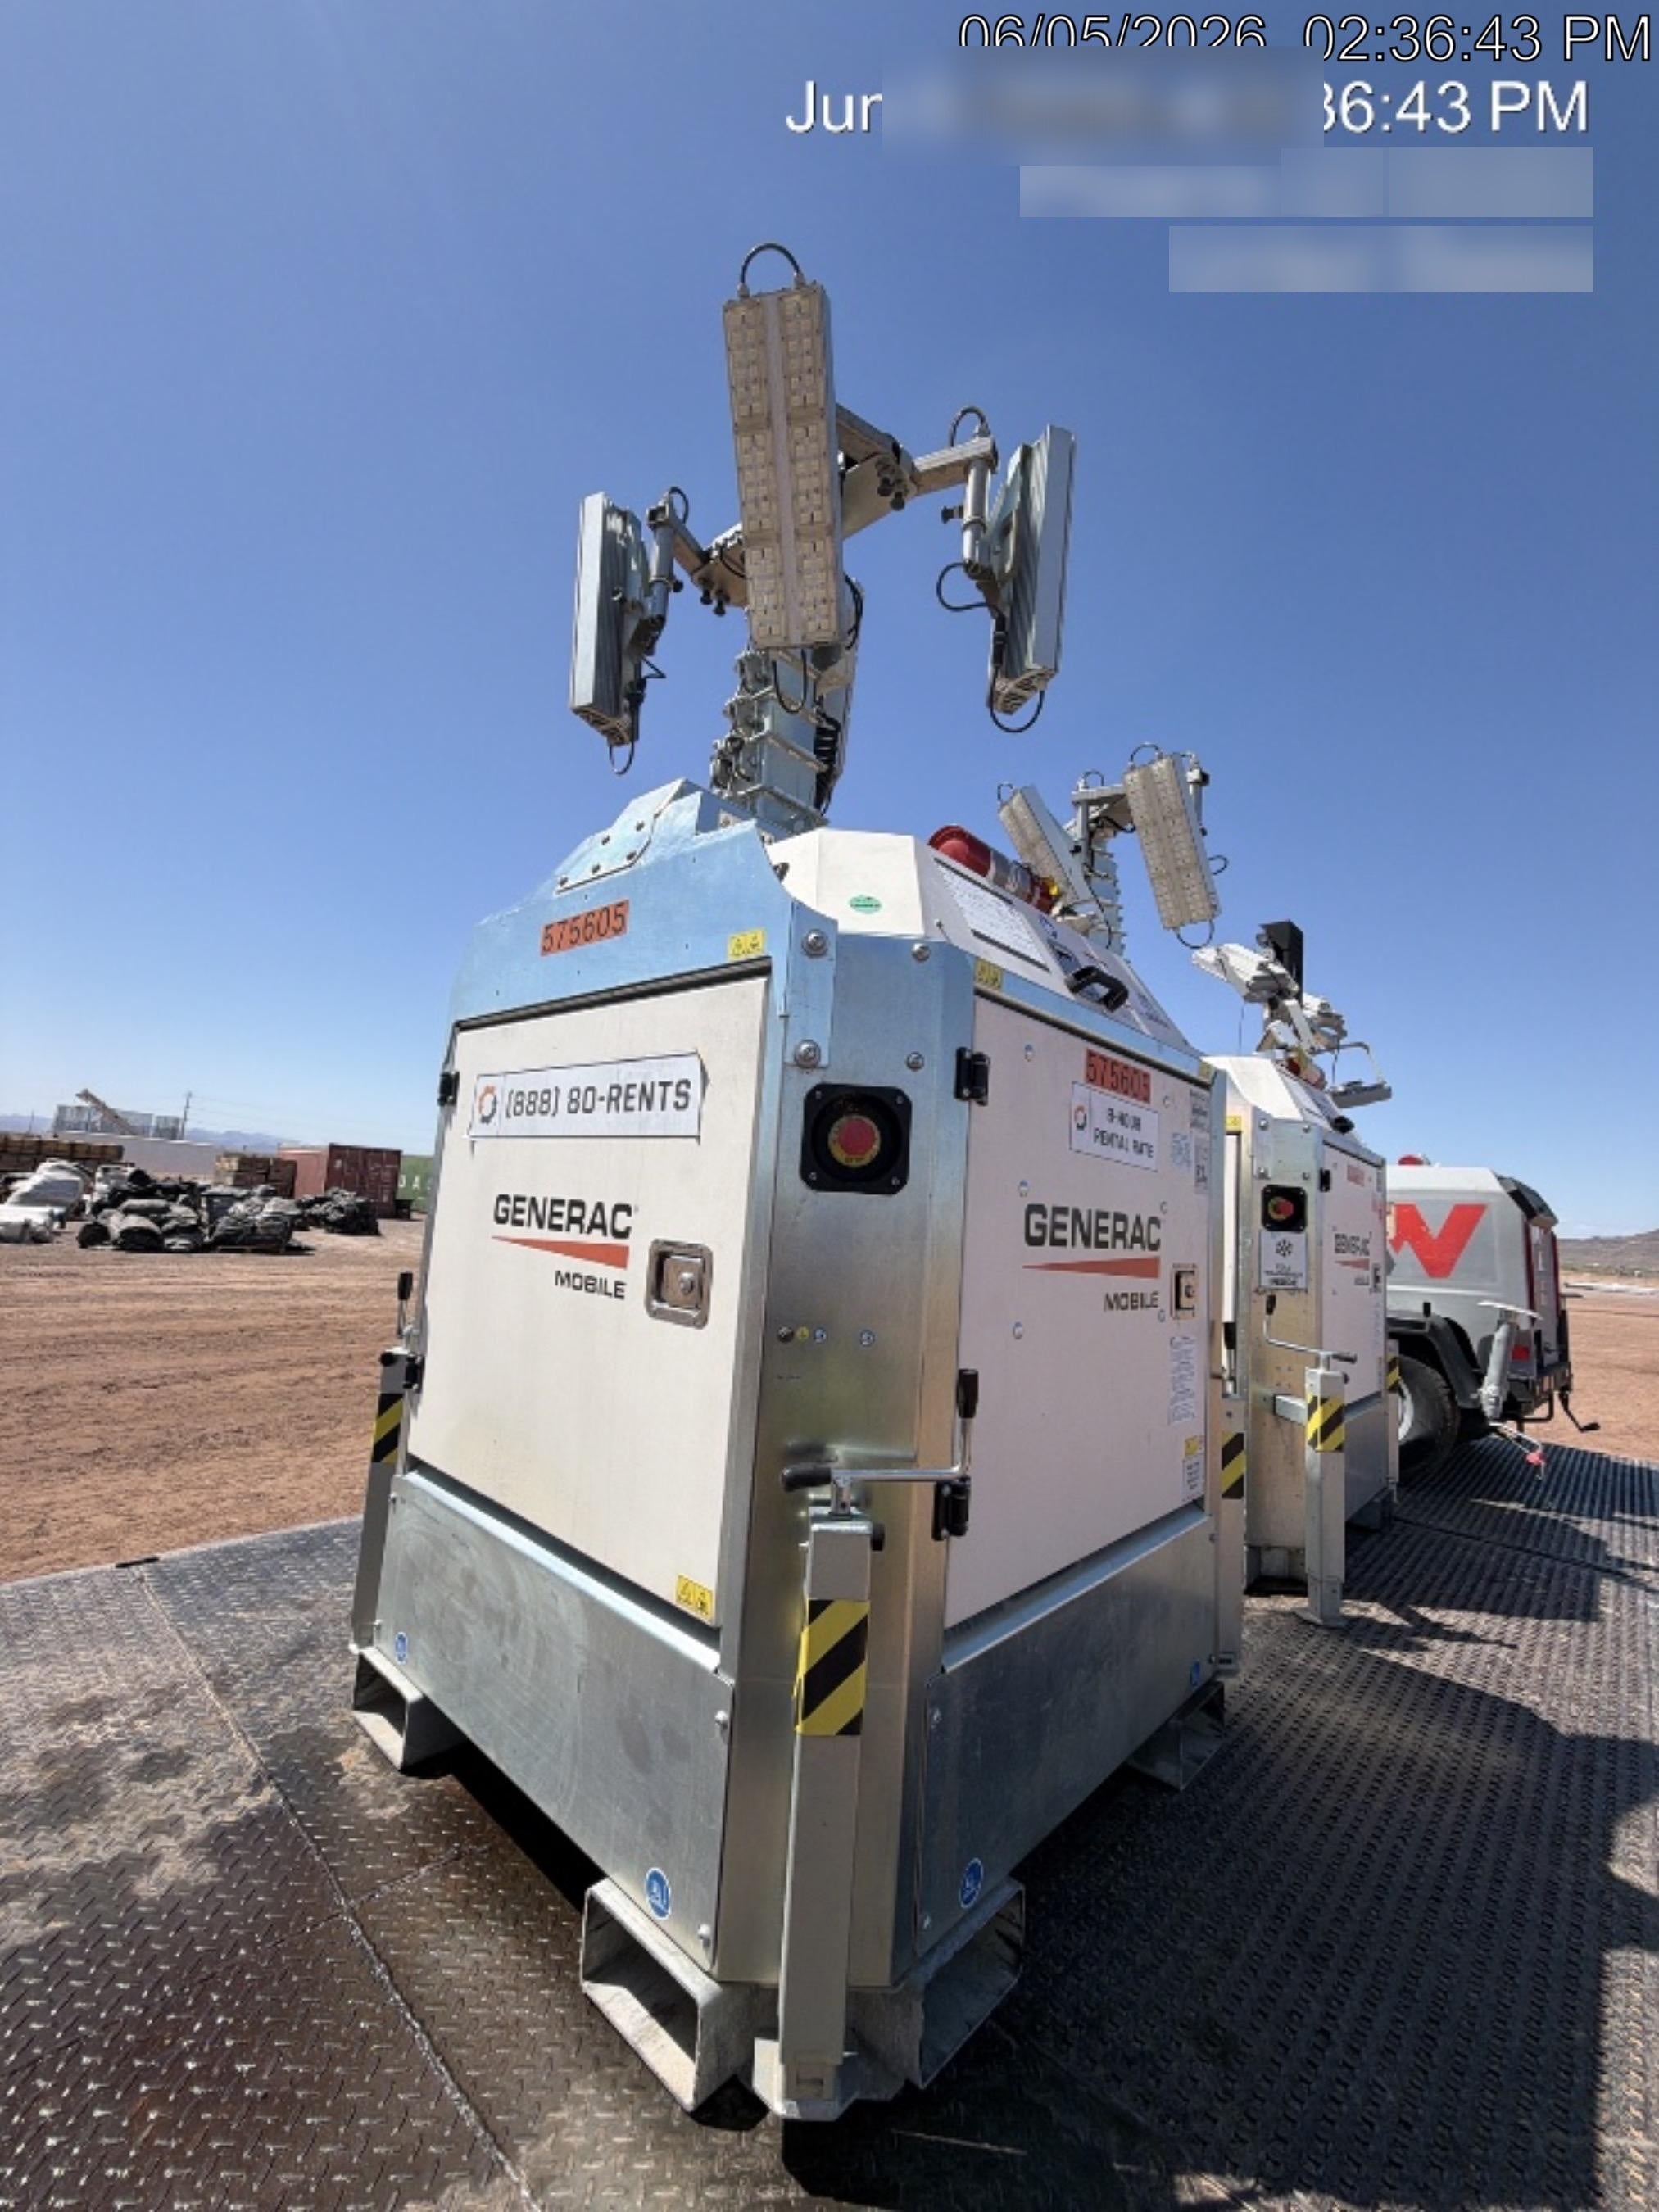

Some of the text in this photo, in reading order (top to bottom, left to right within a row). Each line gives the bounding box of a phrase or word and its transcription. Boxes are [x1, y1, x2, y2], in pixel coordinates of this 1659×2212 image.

[542, 901, 627, 952] 575605
[505, 1079, 692, 1119] (888) 80-RENTS
[493, 1194, 632, 1239] GENERAC
[1025, 1203, 1161, 1251] GENERAC
[554, 1270, 627, 1300] MOBILE
[1104, 1291, 1158, 1312] MOBILE
